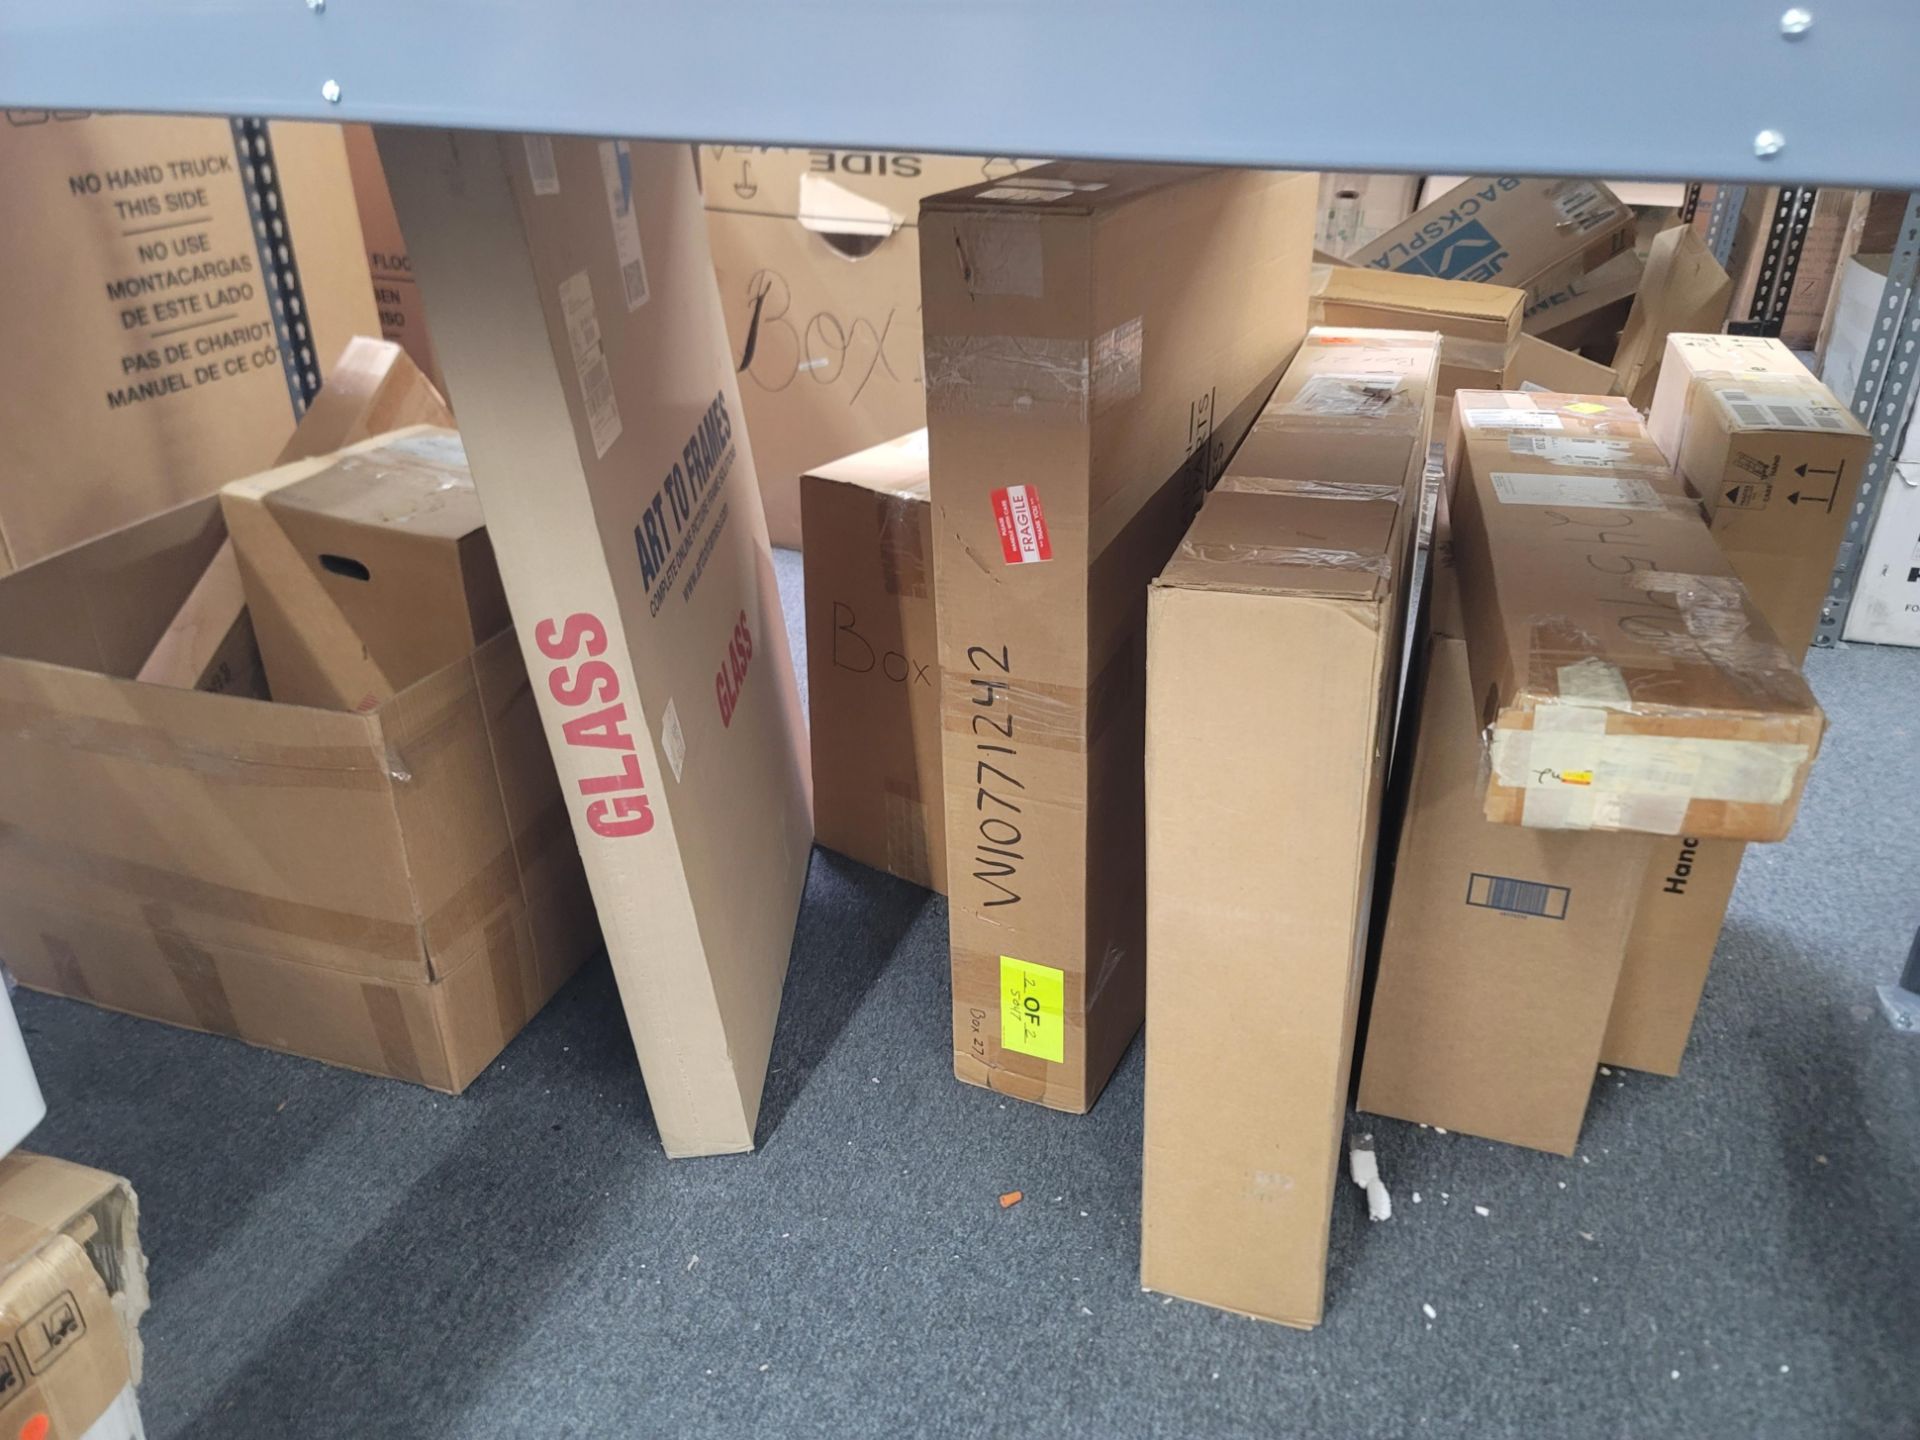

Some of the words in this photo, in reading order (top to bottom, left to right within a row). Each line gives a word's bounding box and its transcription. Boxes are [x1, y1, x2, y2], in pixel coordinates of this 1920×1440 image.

[69, 173, 102, 195] NO
[106, 165, 164, 189] HAND
[168, 156, 232, 177] TRUCK
[810, 150, 922, 178] SIDE
[115, 196, 161, 220] THIS
[165, 189, 208, 212] SIDE
[1366, 177, 1520, 268] BACKSPLA
[138, 243, 168, 263] NO
[173, 234, 211, 256] USE
[106, 255, 253, 301] MONTACARGAS
[122, 307, 149, 330] DE
[154, 295, 202, 322] ESTE
[206, 283, 254, 309] LADO
[122, 351, 161, 376] PAS
[165, 343, 192, 365] DE
[195, 322, 273, 354] CHARIOT
[106, 374, 192, 409] MANUEL
[195, 365, 221, 386] DE
[225, 357, 249, 376] CE
[252, 344, 281, 368] CÔ
[634, 492, 671, 594] ART
[664, 462, 690, 534] TO
[683, 389, 732, 504] FRAMES
[1012, 495, 1035, 552] FRAGILE
[650, 559, 679, 619] COMPLETE
[716, 609, 754, 729] GLASS
[535, 612, 655, 838] GLASS
[970, 1008, 986, 1033] Box
[1024, 997, 1040, 1026] OF
